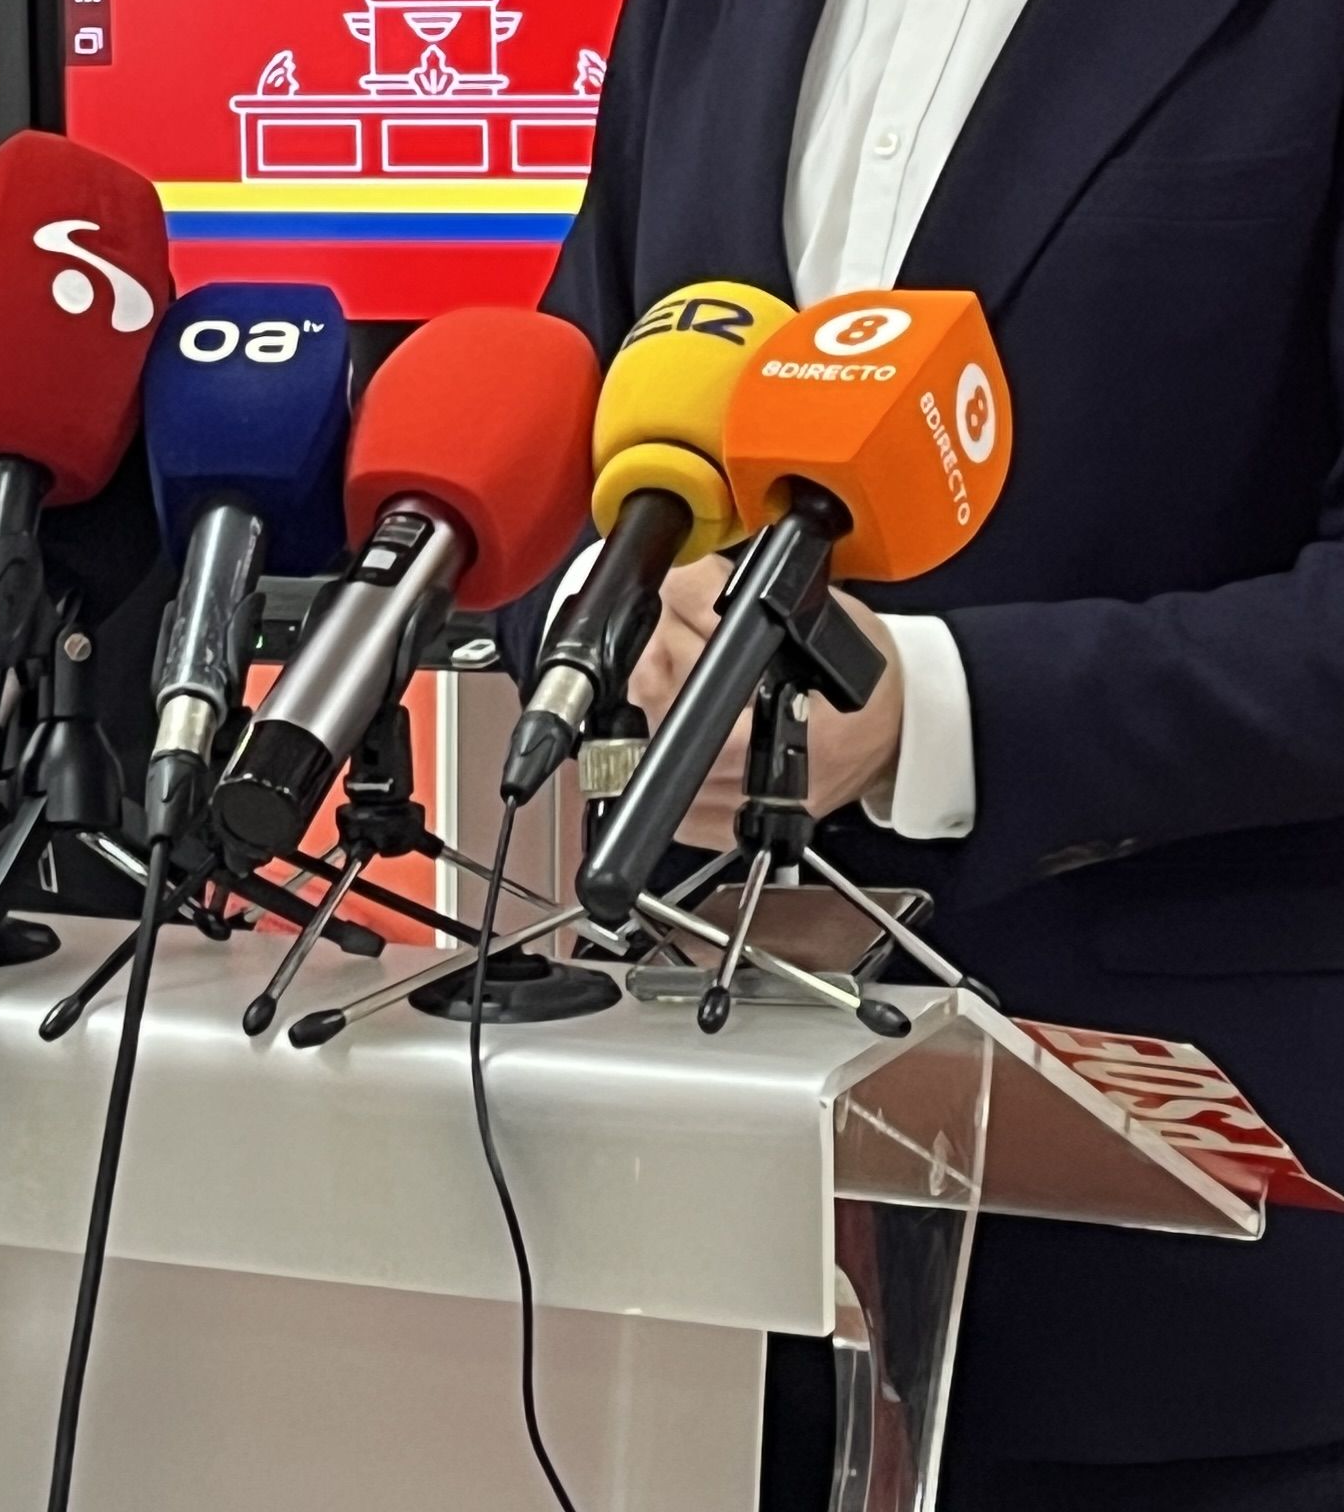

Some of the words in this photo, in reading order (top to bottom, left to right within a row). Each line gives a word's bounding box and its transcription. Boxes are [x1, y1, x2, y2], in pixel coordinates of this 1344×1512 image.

[761, 360, 897, 381] 8DIRECTO
[919, 391, 972, 526] 8DIRECTO
[1038, 1026, 1295, 1161] PSOE
